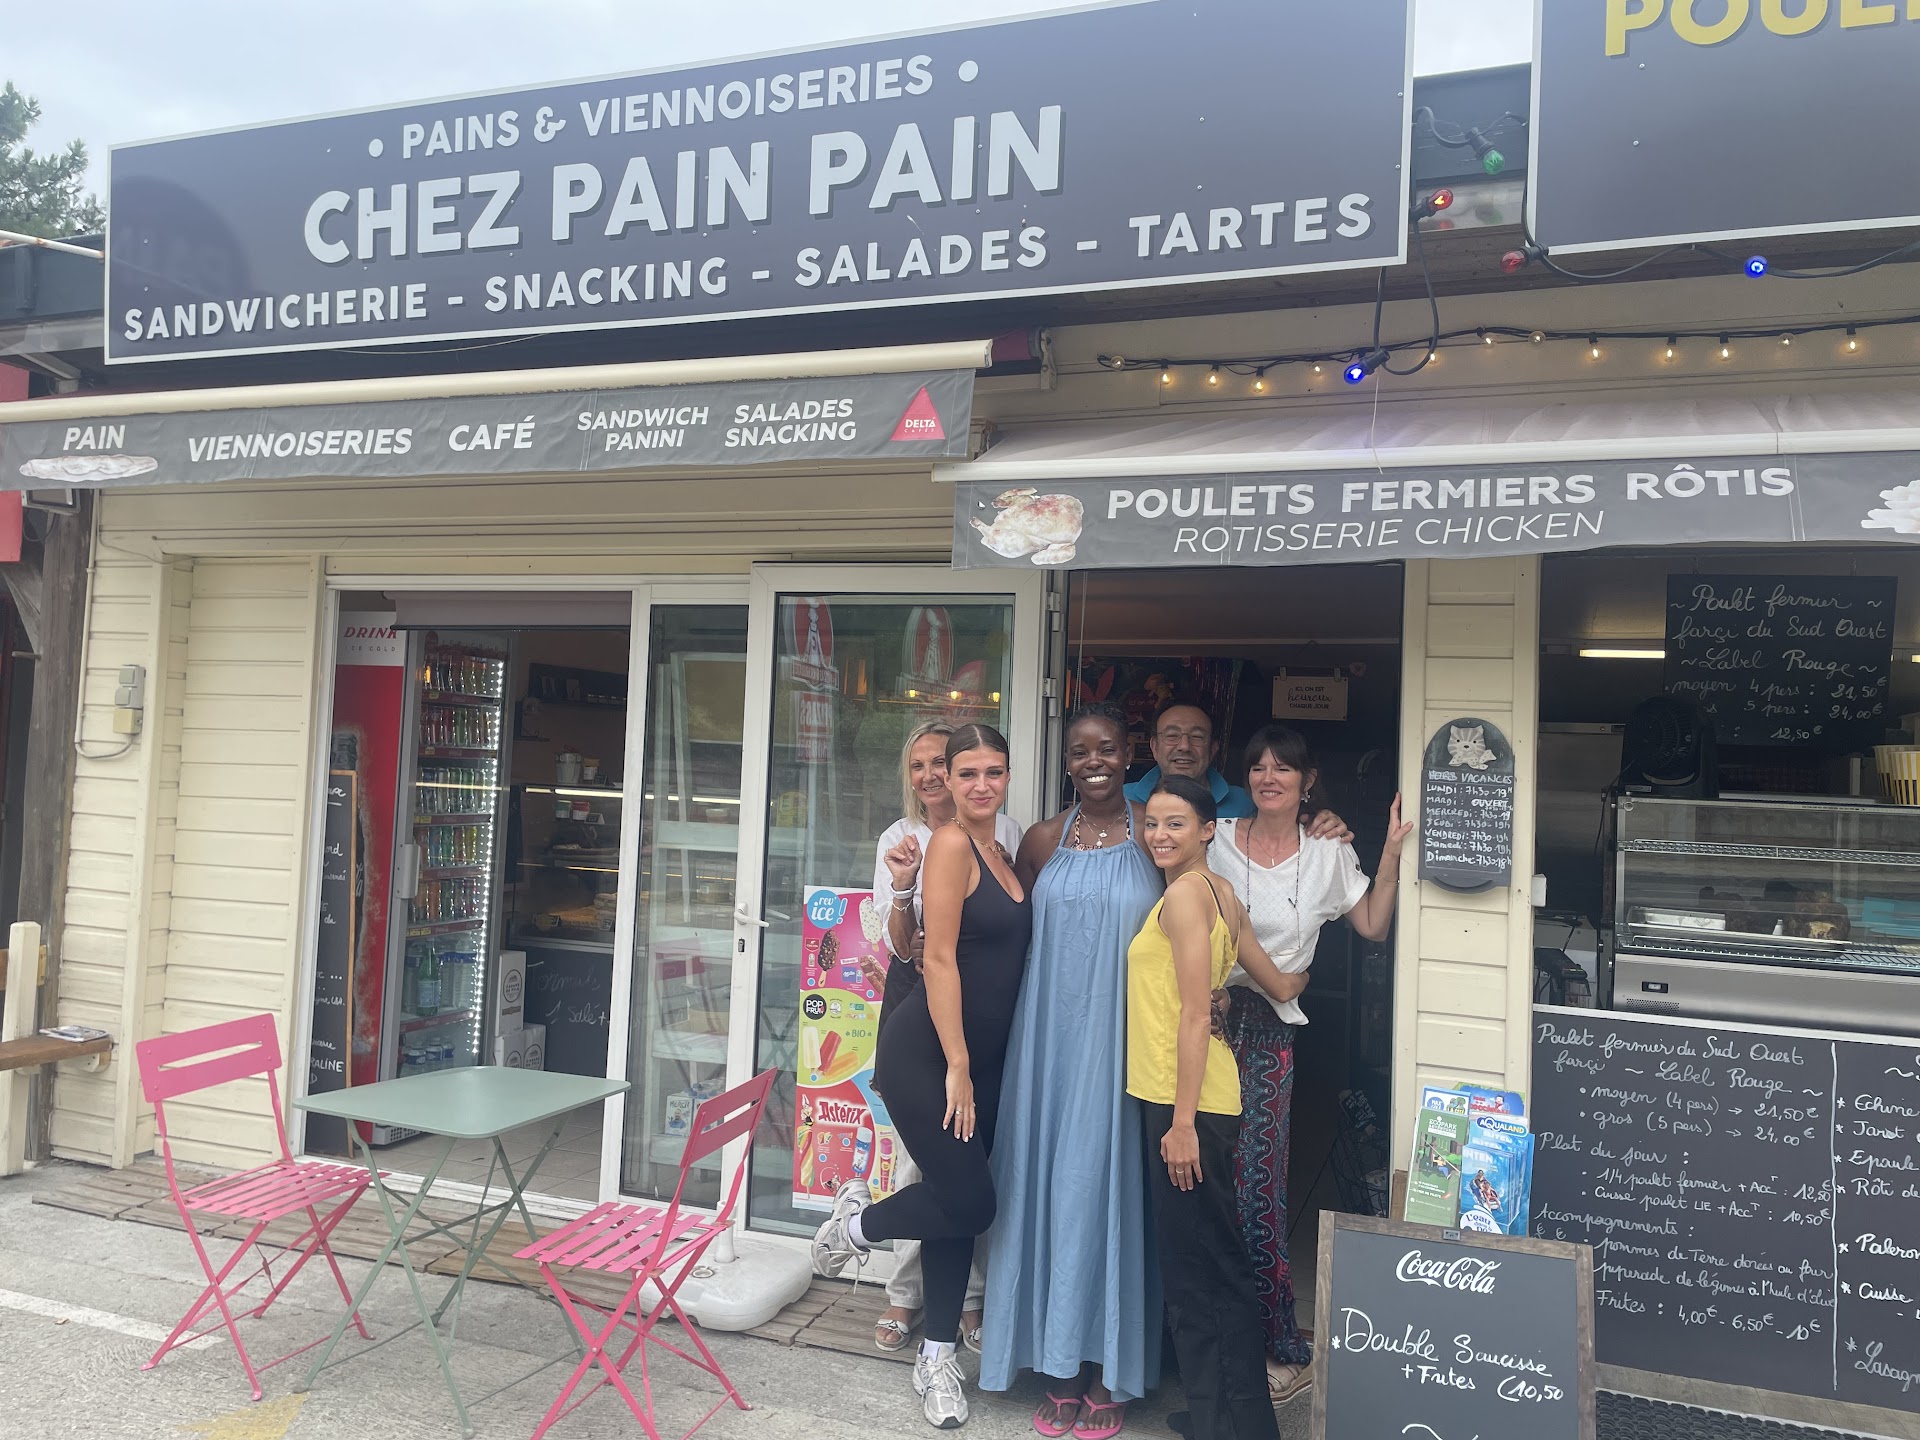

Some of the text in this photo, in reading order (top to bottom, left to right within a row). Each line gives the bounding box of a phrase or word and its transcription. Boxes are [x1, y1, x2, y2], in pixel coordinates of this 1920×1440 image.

[403, 55, 934, 159] PAINS & VIENNOISERIES
[304, 105, 1062, 264] CHEZ PAIN PAIN
[124, 193, 1371, 342] SANDWICHERIE SNACKING SALADES TARTES
[577, 406, 709, 431] SANDWICH
[734, 398, 853, 424] SALADES
[905, 419, 936, 428] DELTA
[62, 424, 126, 452] PAIN
[187, 427, 413, 462] VIENNOISERIES
[448, 414, 536, 452] CAFÉ
[604, 428, 685, 451] PANINI
[724, 421, 857, 448] SNACKING
[1107, 463, 1796, 519] POULETS FERMIERS RÔTIS
[1173, 510, 1605, 553] ROTISSERIE CHICKEN
[1689, 583, 1853, 617] Poulet fermier
[344, 626, 397, 639] DRINK
[1746, 619, 1774, 638] du
[1786, 615, 1826, 637] Sud
[1835, 618, 1887, 639] Ouest
[1698, 648, 1855, 680] Label Rouge
[1671, 679, 1737, 699] moyen
[1749, 679, 1759, 693] 4
[1761, 683, 1800, 702] pers
[1743, 699, 1756, 712] 5
[1761, 701, 1796, 717] pers
[1461, 772, 1514, 784] VACANCES
[567, 1002, 600, 1025] Salé
[805, 999, 824, 1008] POP
[852, 1029, 866, 1038] BIO
[1537, 1022, 1805, 1066] Poulet fermier du Sud Ouest
[1552, 1049, 1793, 1100] farçi Label Rouge
[1590, 1086, 1658, 1108] moyen
[1666, 1091, 1682, 1110] (4
[1686, 1095, 1719, 1116] pers)
[1854, 1093, 1920, 1117] Echine
[1429, 1118, 1458, 1131] ECOPARK
[1480, 1117, 1524, 1134] AQUALAND
[1592, 1111, 1634, 1130] gros
[1646, 1111, 1668, 1132] (5
[1672, 1118, 1713, 1137] pers)
[1539, 1131, 1667, 1167] Plat du jour
[1848, 1149, 1920, 1175] Epaule
[1596, 1167, 1623, 1184] 1/4
[1623, 1171, 1672, 1191] poulet
[1676, 1170, 1731, 1195] fermier
[1850, 1177, 1895, 1196] Rôti
[1594, 1185, 1637, 1202] Cuisse
[1639, 1193, 1688, 1212] poulet
[1533, 1202, 1679, 1235] Accompagnements
[1396, 1249, 1501, 1294] Coca-Cola
[1593, 1237, 1660, 1259] pommes
[1667, 1246, 1689, 1260] de
[1688, 1249, 1730, 1267] Terre
[1733, 1251, 1774, 1271] dorées
[1798, 1259, 1834, 1282] four
[1593, 1261, 1671, 1285] piperade
[1676, 1270, 1694, 1287] de
[1696, 1269, 1745, 1296] légumes
[1596, 1289, 1647, 1313] Frites
[1858, 1282, 1914, 1303] Cuisse
[1340, 1307, 1553, 1378] Double Saucisse
[1417, 1364, 1477, 1390] Frites
